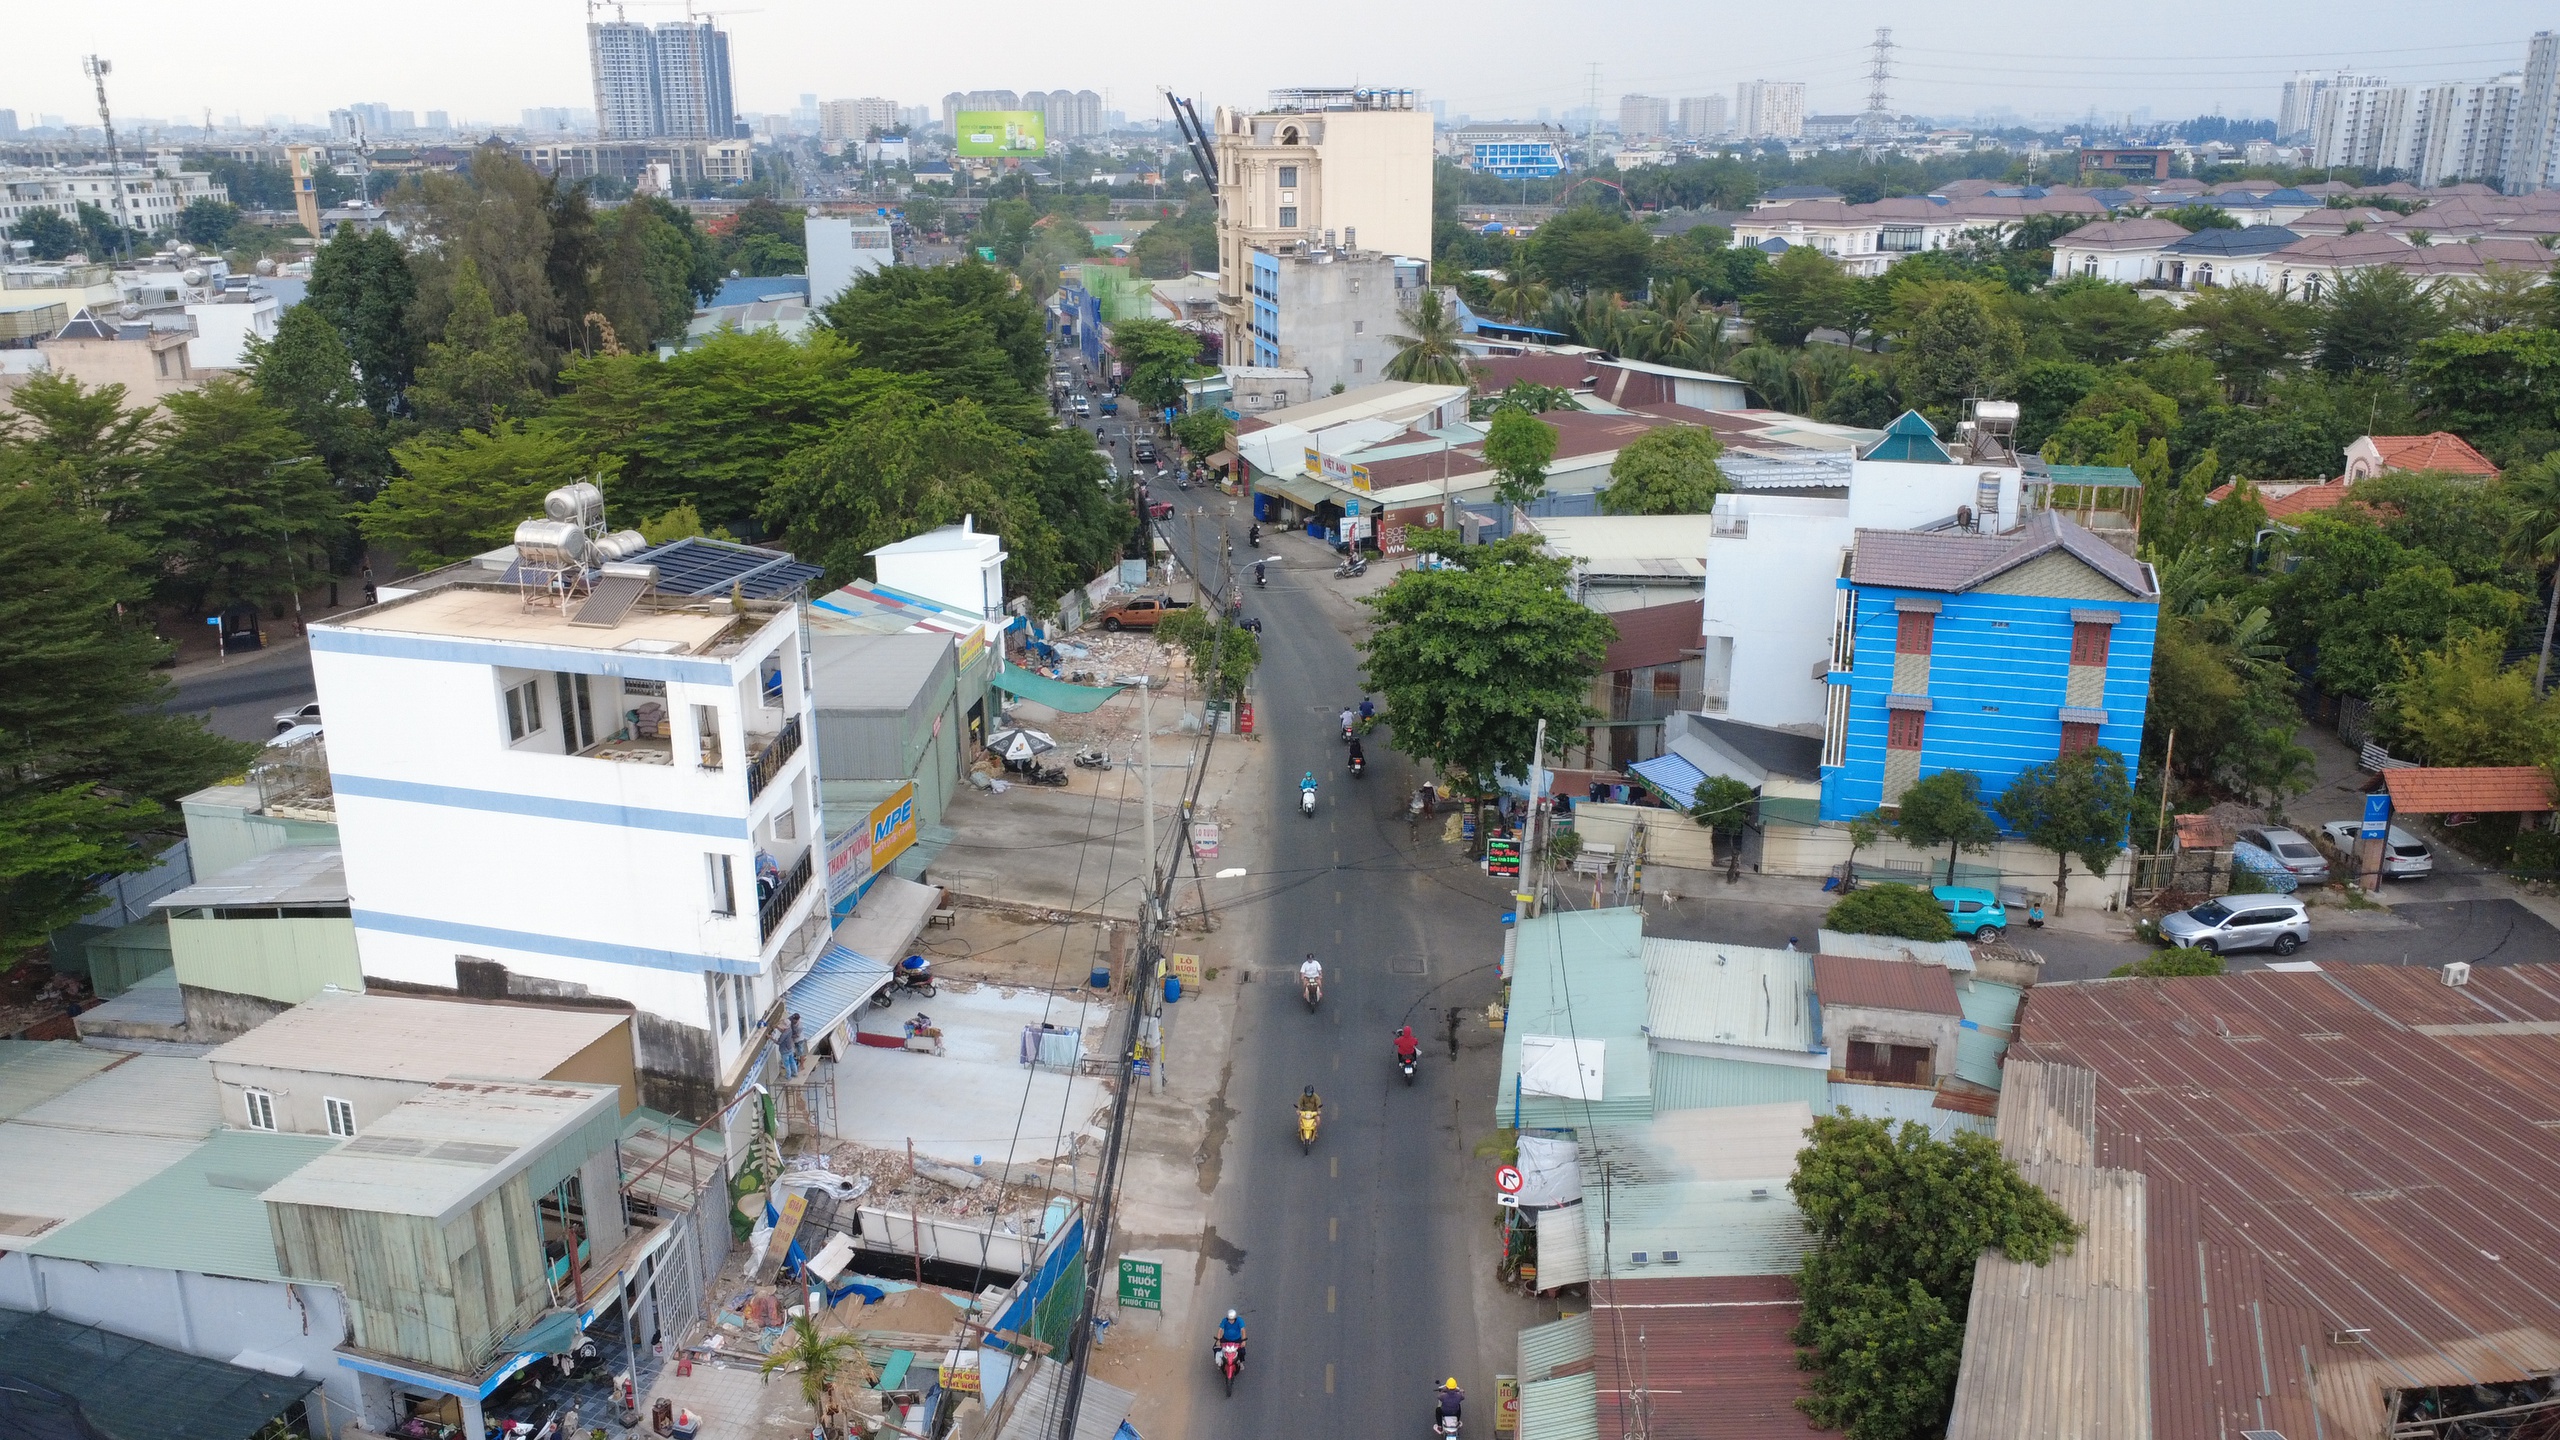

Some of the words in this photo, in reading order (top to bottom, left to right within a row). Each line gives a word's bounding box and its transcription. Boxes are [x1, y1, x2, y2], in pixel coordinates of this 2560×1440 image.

[873, 797, 912, 845] MPE
[1136, 1264, 1154, 1275] NHÀ
[1127, 1275, 1157, 1287] THUỐC
[1133, 1287, 1150, 1298] TÂY
